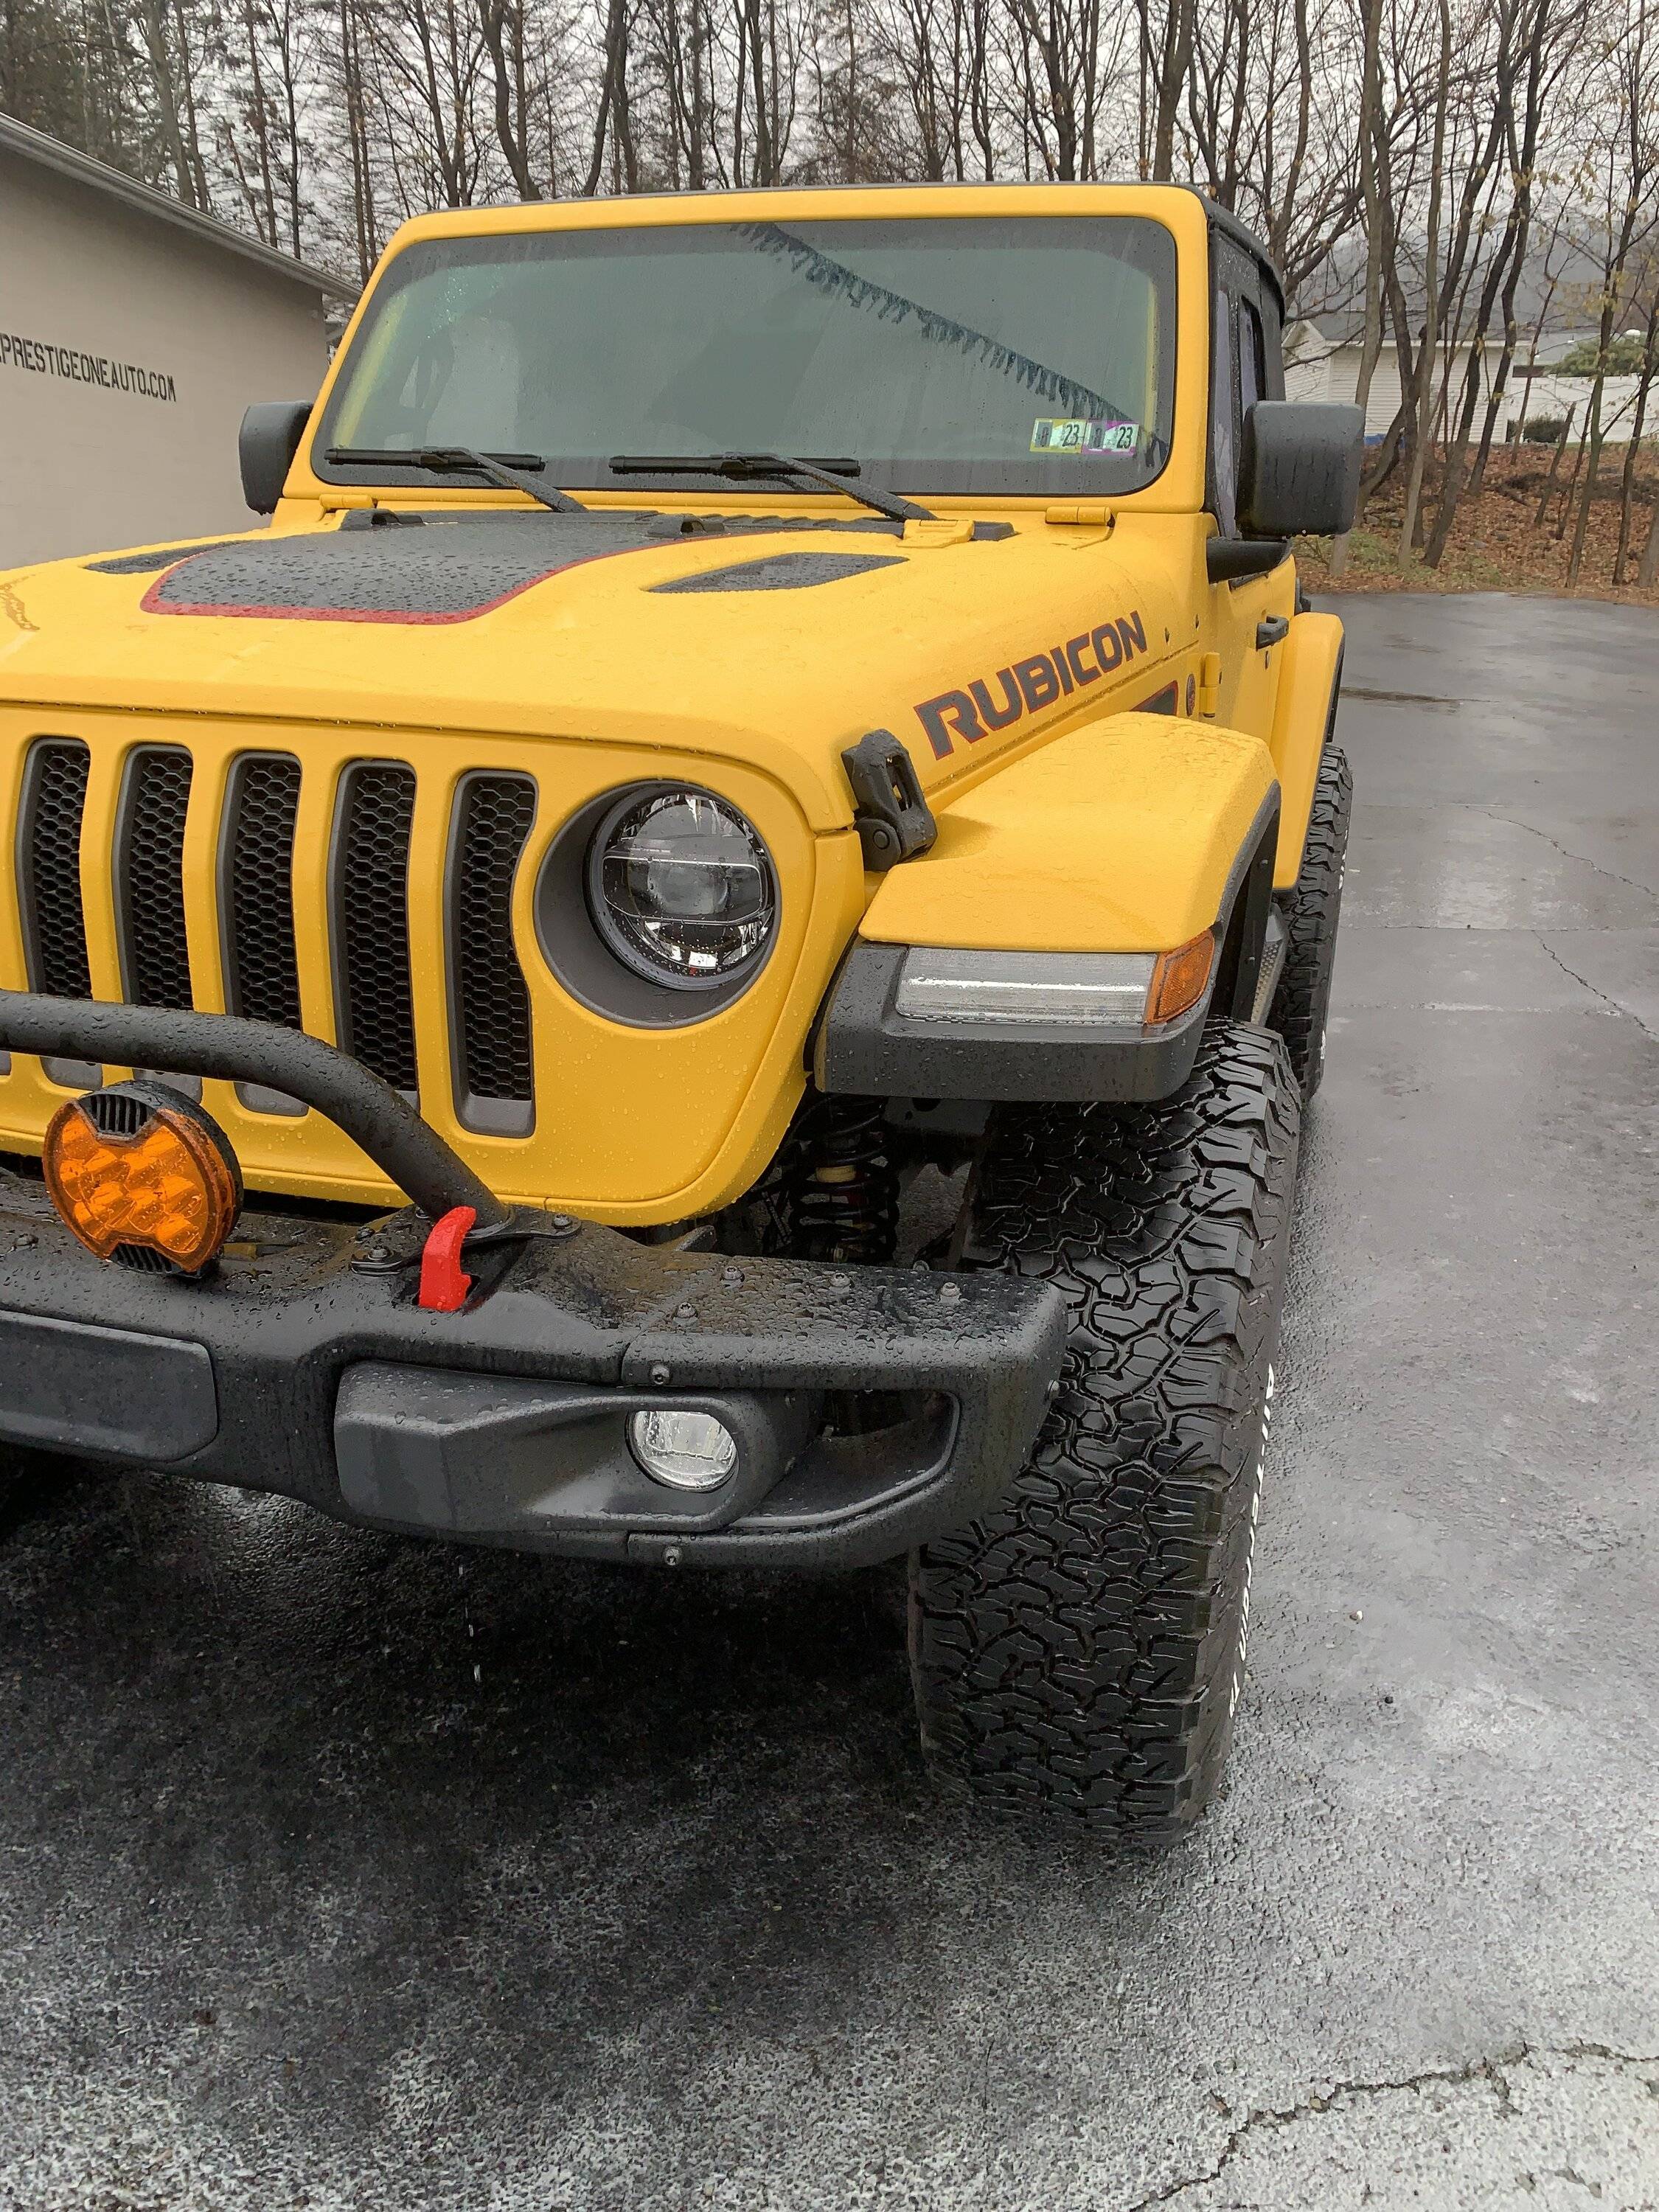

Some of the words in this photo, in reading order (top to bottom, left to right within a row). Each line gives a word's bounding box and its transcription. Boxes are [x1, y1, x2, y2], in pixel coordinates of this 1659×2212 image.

[1062, 424, 1080, 447] 23
[1116, 426, 1133, 449] 23
[913, 610, 1148, 761] RUBICON
